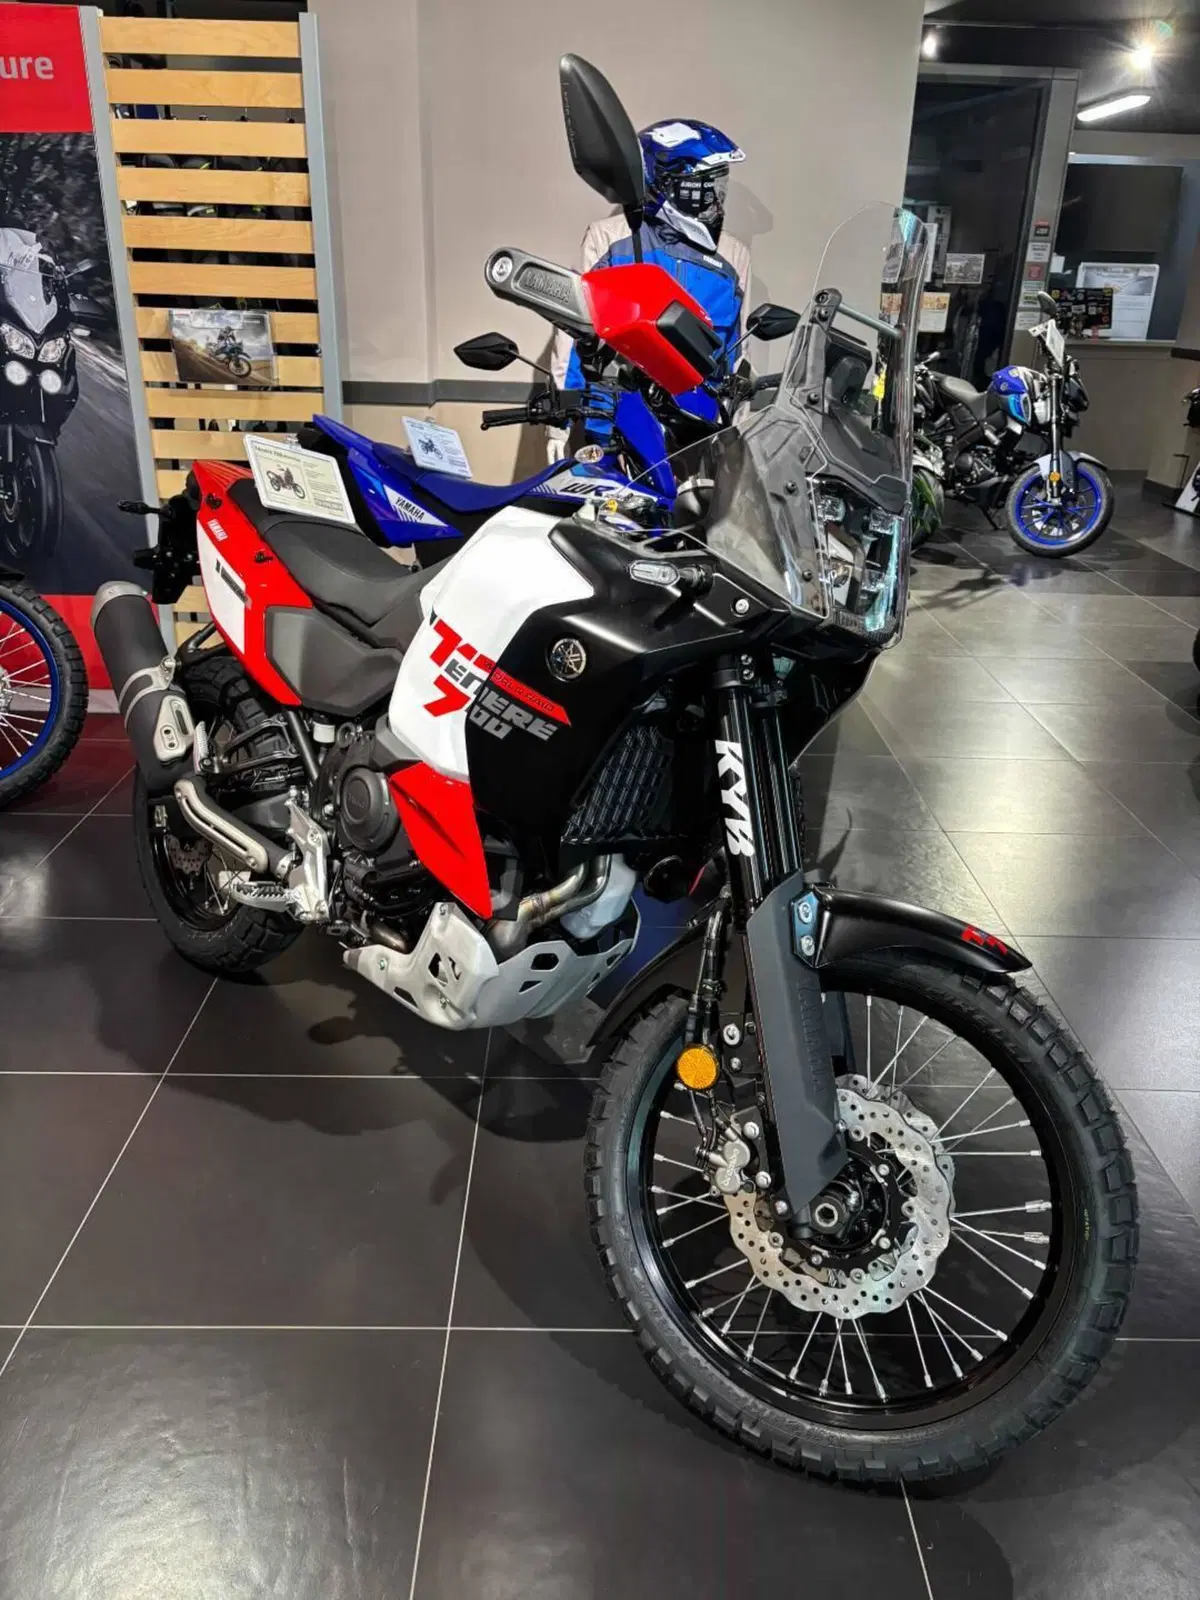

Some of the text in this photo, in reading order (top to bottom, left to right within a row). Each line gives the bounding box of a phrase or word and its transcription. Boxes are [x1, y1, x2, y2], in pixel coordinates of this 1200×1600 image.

[0, 56, 54, 80] ure
[395, 496, 425, 521] YAMAHA
[714, 739, 755, 858] KYB
